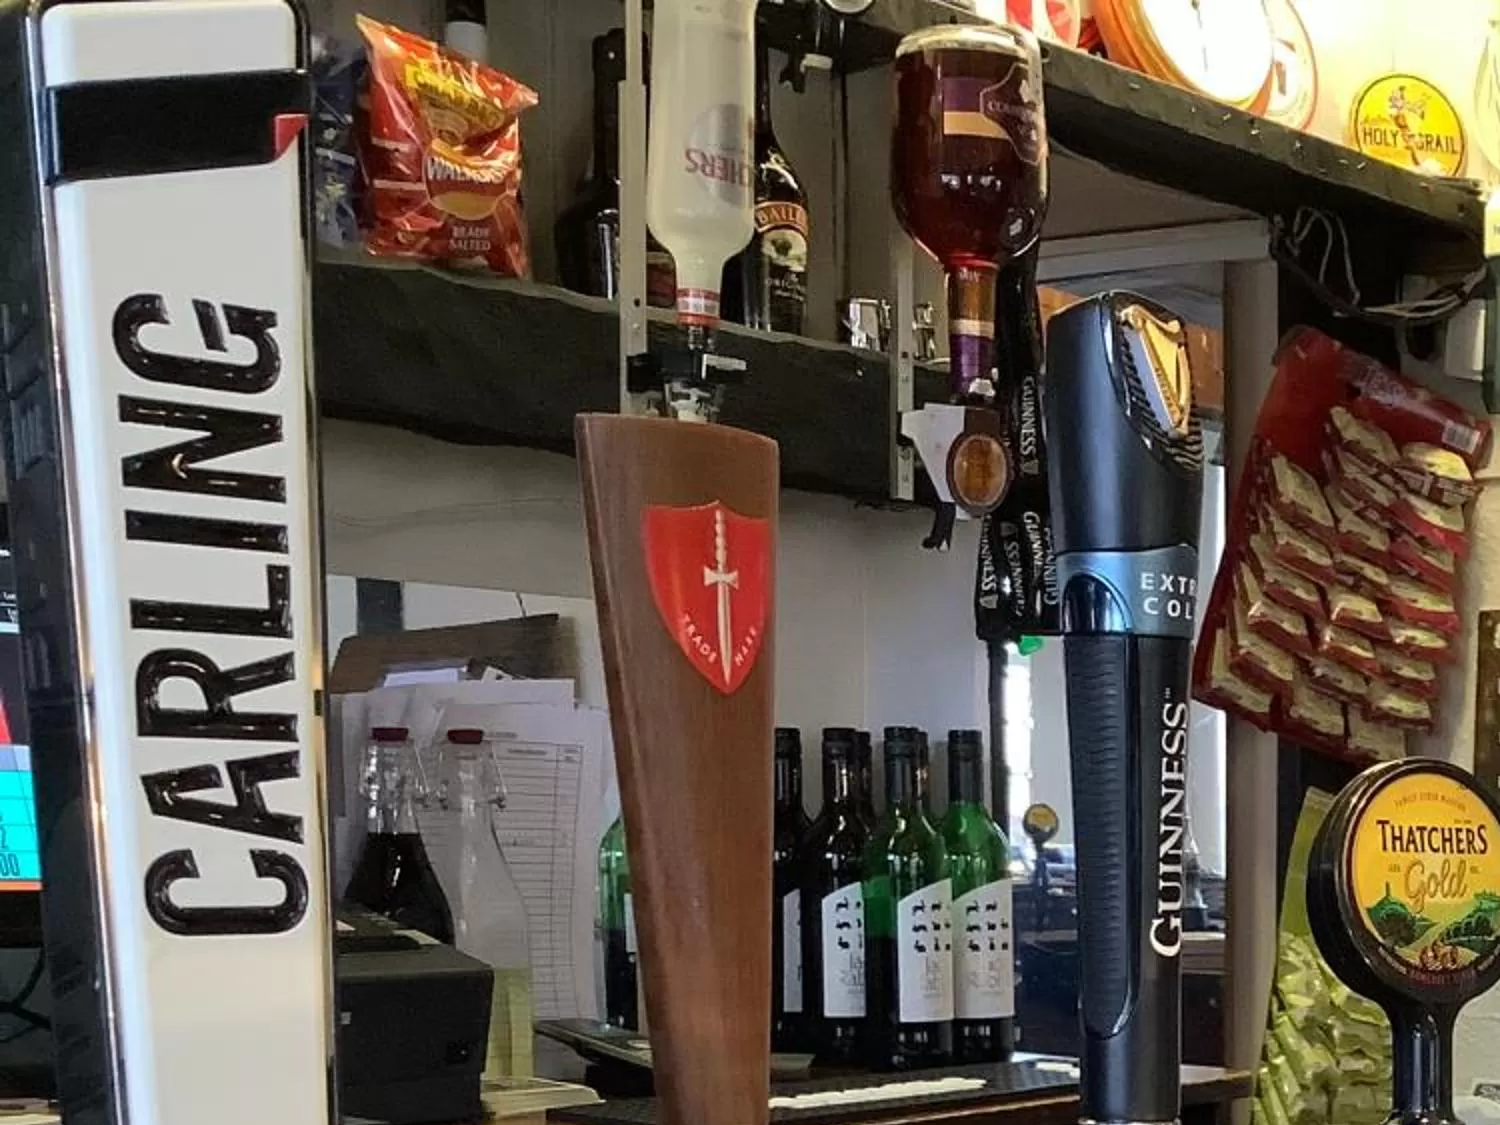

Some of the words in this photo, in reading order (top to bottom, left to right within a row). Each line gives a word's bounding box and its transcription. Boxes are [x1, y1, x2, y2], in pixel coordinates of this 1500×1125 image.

[1362, 126, 1399, 149] HOLY
[111, 292, 310, 937] CARLING
[1150, 702, 1188, 957] GUINNESS
[1376, 818, 1488, 854] THATCHERS
[1404, 857, 1467, 915] Gold
